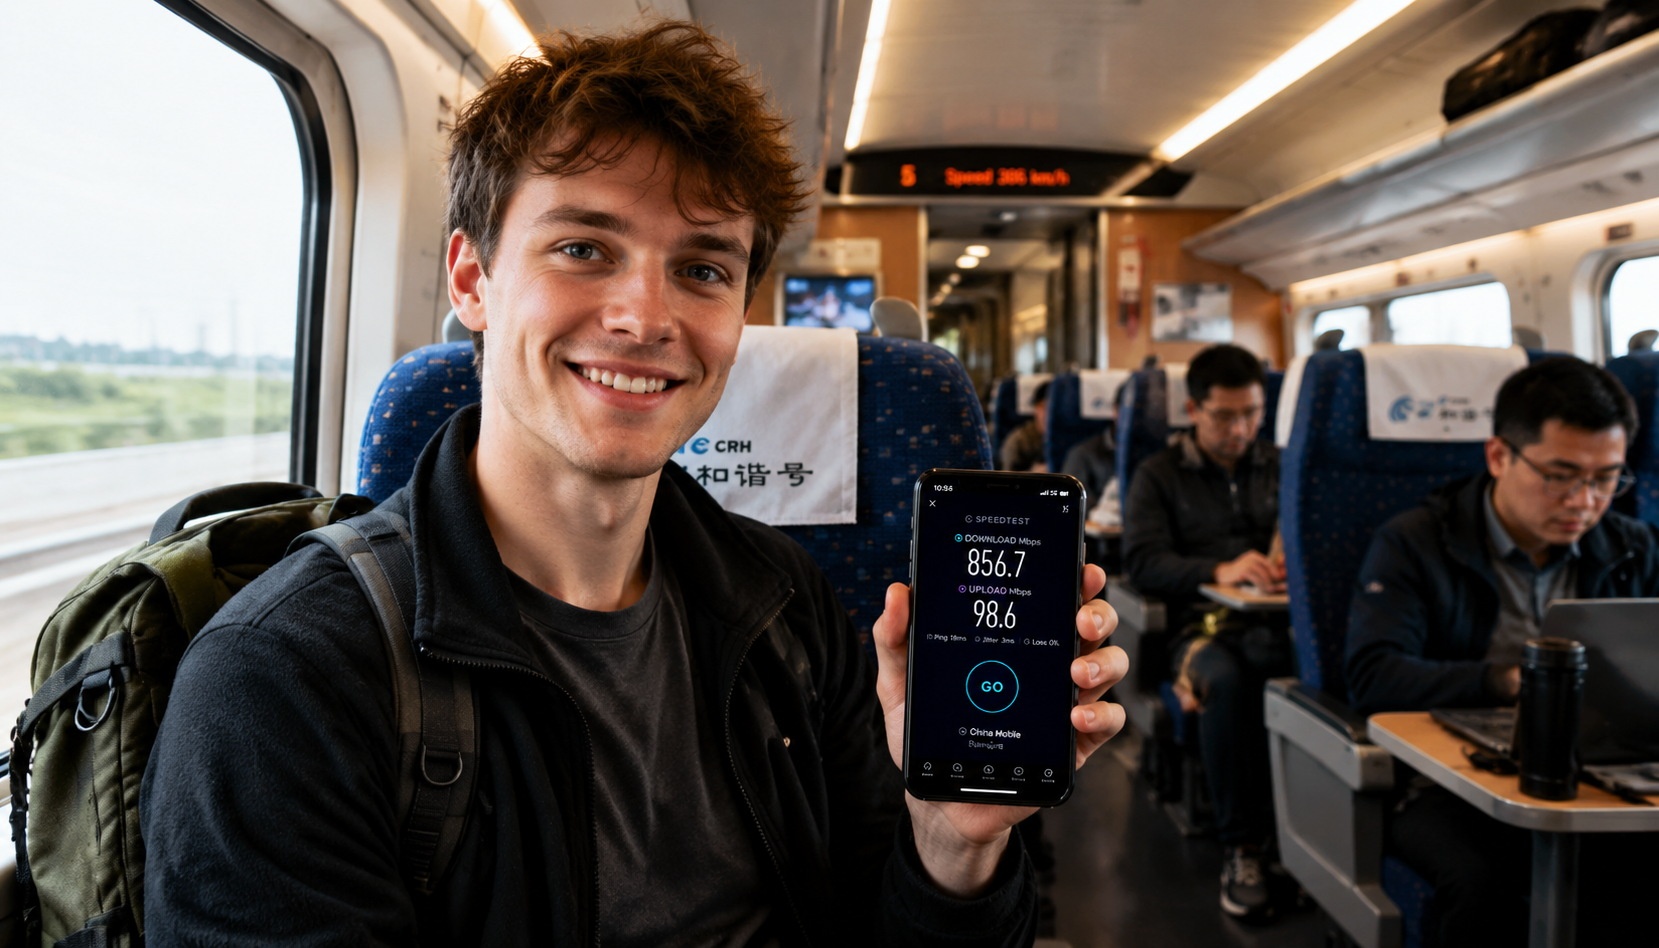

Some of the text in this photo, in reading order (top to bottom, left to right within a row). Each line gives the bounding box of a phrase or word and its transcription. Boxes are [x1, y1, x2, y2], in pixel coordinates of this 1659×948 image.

[945, 167, 994, 188] Speed
[714, 440, 752, 453] CRH
[684, 462, 814, 487] 和谐号
[975, 516, 1030, 525] SPEEDTEST
[964, 534, 1042, 547] DOWNLOAD Mbps
[967, 548, 1026, 578] 856.7
[968, 585, 1032, 597] UPLOAD Mbps
[973, 599, 1016, 629] 98.6
[981, 681, 1004, 693] GO
[969, 727, 1021, 739] China Mobile
